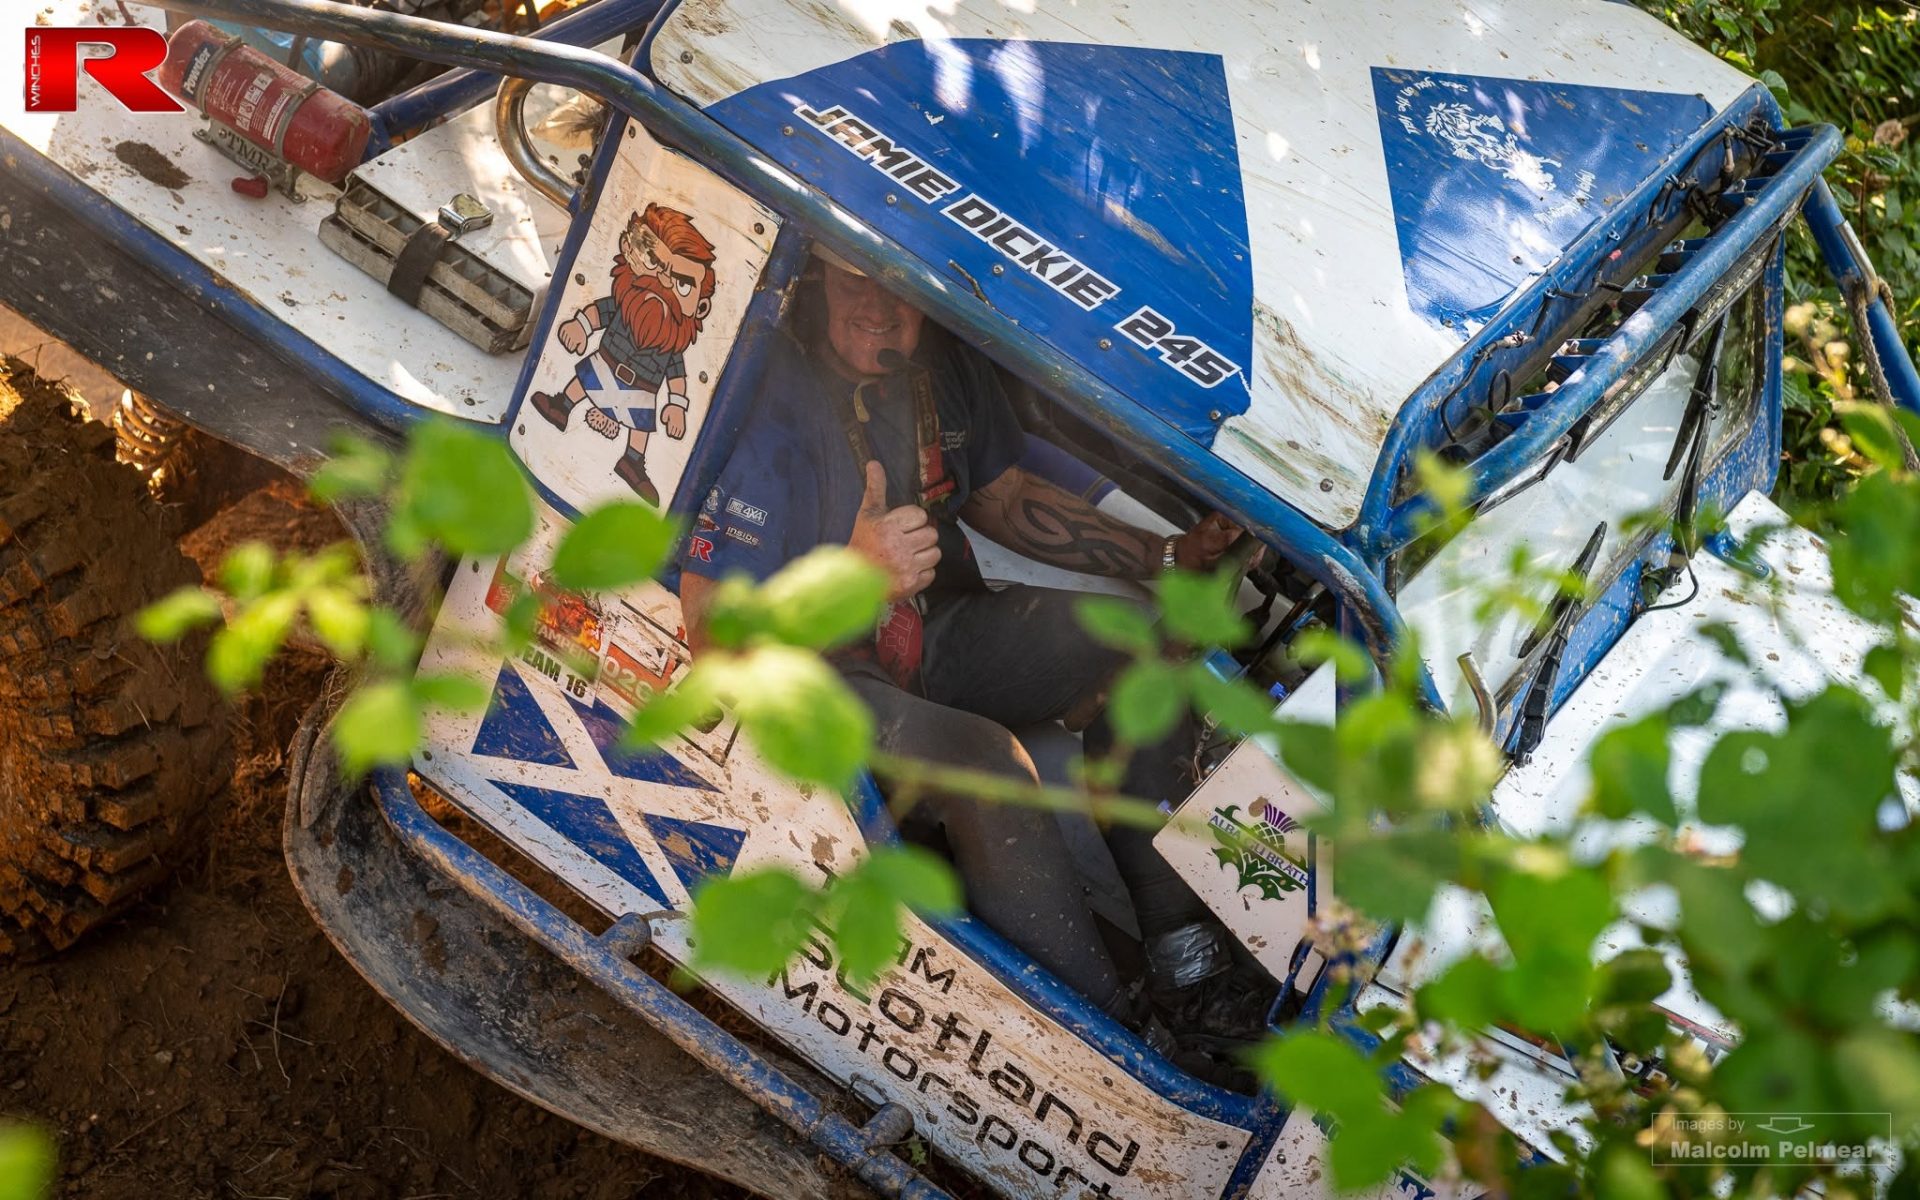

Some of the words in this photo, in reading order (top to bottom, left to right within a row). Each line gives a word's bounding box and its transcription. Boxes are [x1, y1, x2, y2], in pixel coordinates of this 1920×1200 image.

[183, 47, 212, 95] Powder
[794, 104, 961, 203] JAMIE
[941, 193, 1121, 310] DICKIE
[1113, 305, 1241, 388] 245
[566, 673, 588, 698] 16
